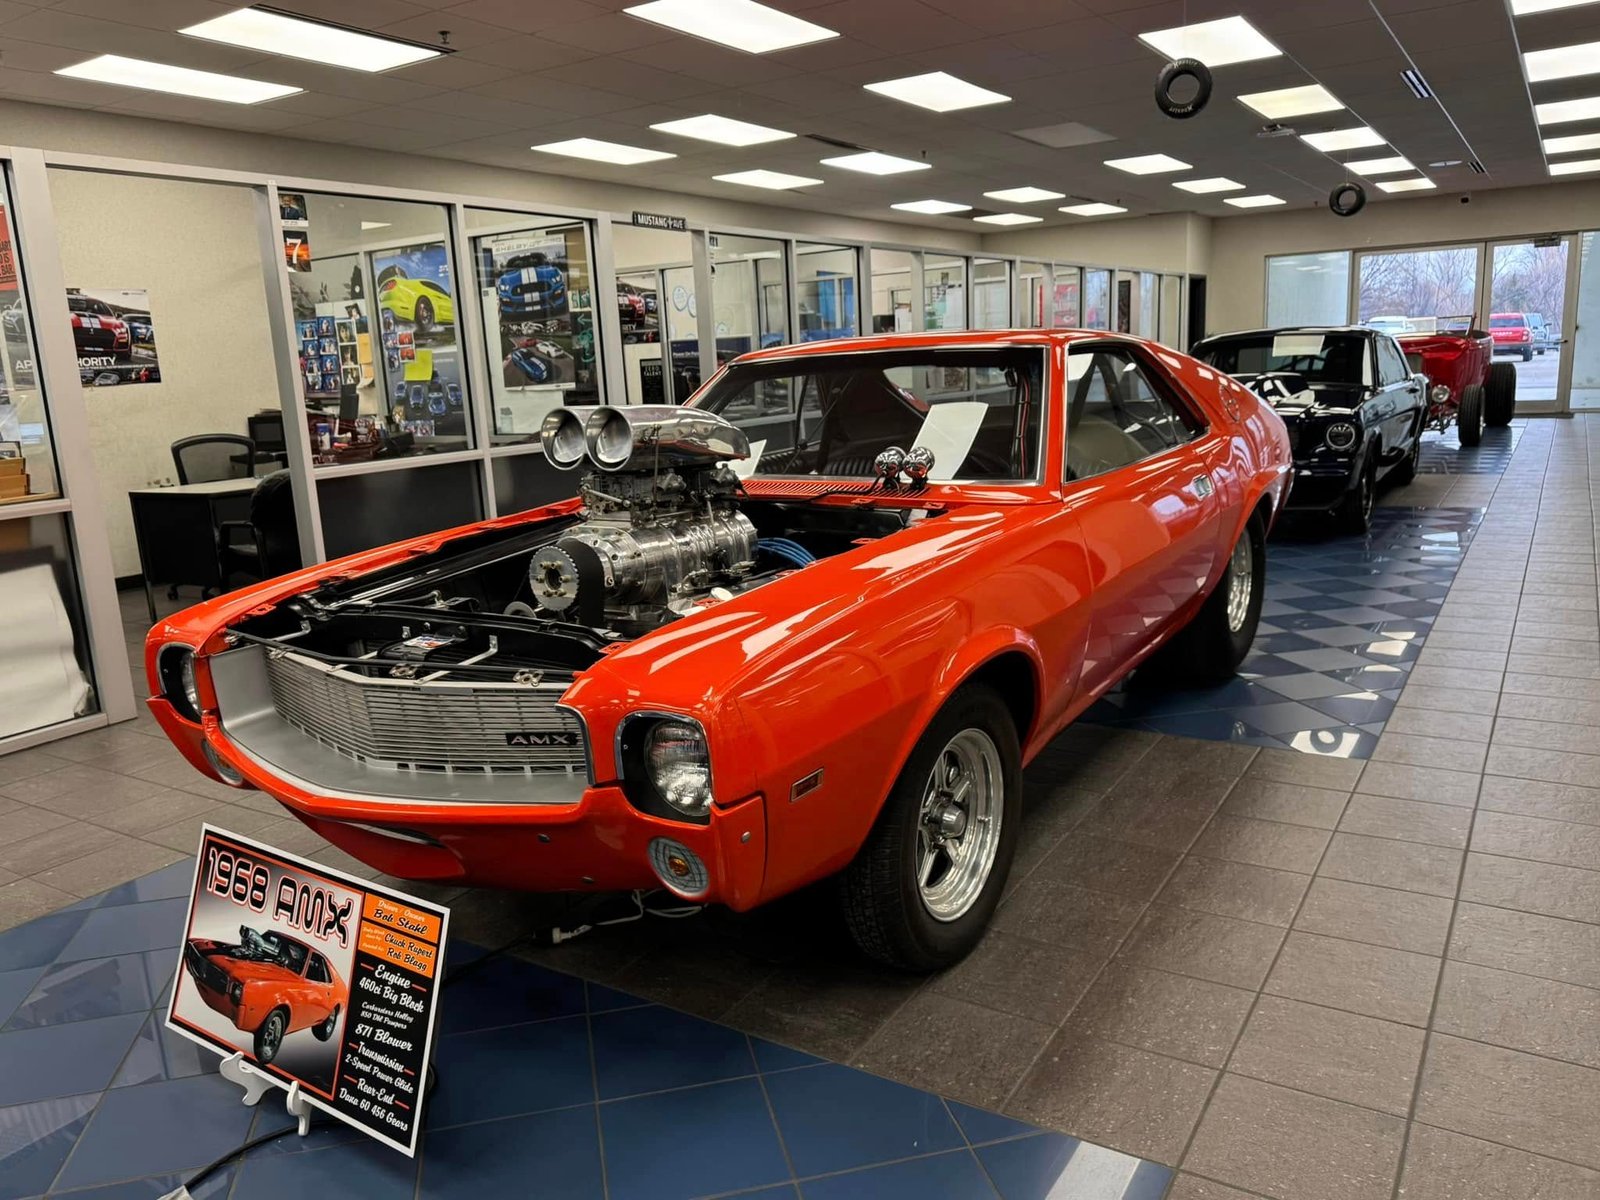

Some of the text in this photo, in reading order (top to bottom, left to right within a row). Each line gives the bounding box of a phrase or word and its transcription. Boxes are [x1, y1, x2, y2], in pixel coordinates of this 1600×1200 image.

[637, 213, 668, 227] MUSTANG
[672, 219, 684, 229] AVE
[286, 238, 301, 264] 7
[15, 360, 33, 370] AP
[77, 357, 116, 367] HORITY
[511, 734, 571, 745] AMX
[206, 847, 354, 949] 1968 AMX
[373, 908, 394, 922] Bob
[396, 917, 428, 935] Stahl
[384, 933, 407, 948] Chuck
[407, 942, 433, 958] Rupert
[387, 947, 402, 960] Rob
[374, 964, 411, 989] Engine
[359, 976, 424, 1013] 460ci Big Block
[355, 1023, 413, 1052] 871 Blower
[357, 1041, 404, 1073] Transmission
[345, 1053, 414, 1094] 2-Speed Power Glide
[357, 1078, 396, 1105] Rear-End
[339, 1087, 409, 1131] Dana 60 456 Gears
